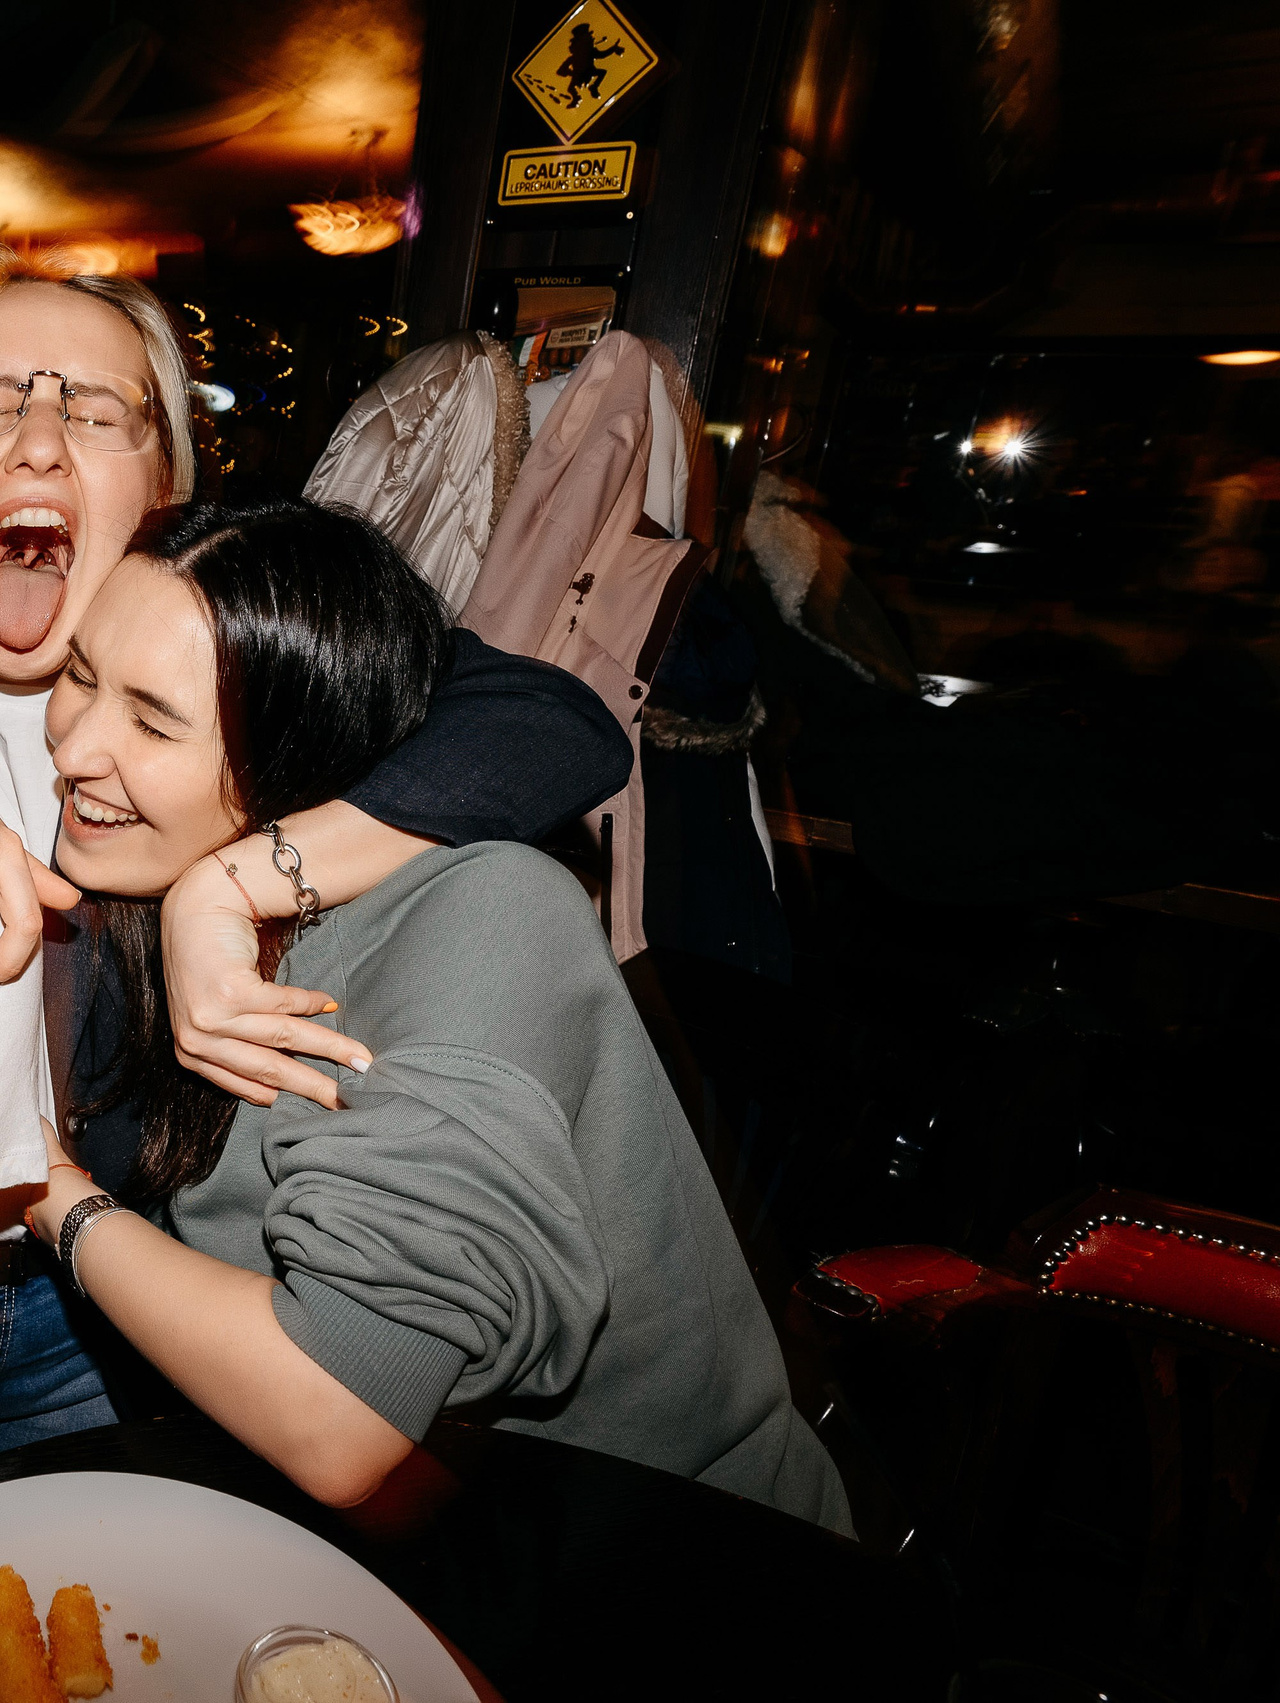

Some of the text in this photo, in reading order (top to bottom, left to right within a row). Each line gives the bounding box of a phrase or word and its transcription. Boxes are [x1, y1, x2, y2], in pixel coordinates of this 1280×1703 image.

[524, 159, 607, 180] CAUTION
[510, 176, 620, 194] LEPRECHAUNS CROSSING
